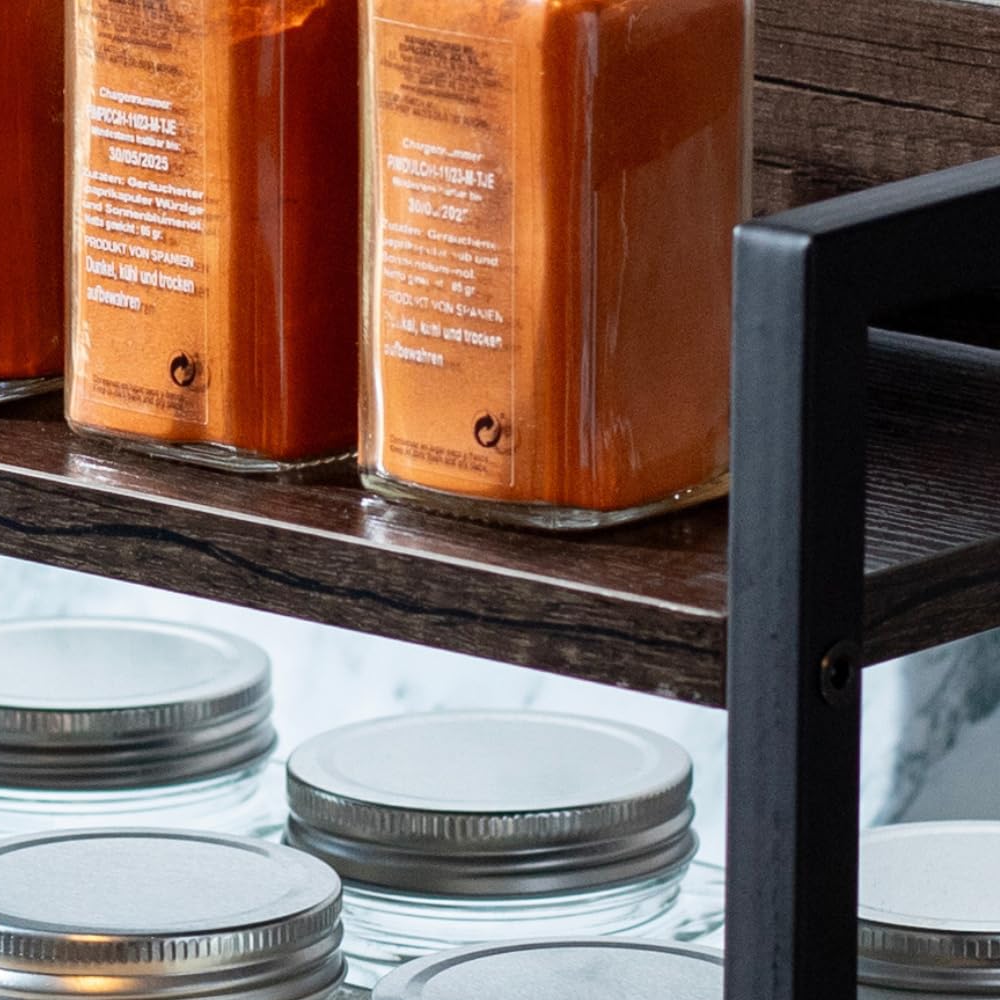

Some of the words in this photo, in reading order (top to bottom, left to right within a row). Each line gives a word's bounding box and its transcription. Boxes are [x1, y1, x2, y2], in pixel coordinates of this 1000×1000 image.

[108, 146, 170, 172] 30/05/2025
[127, 175, 204, 199] Geräucherter
[84, 235, 127, 255] PRODUKT
[129, 244, 150, 260] VON
[151, 249, 194, 268] SPANIEN
[474, 255, 498, 268] und
[139, 269, 158, 287] und
[159, 271, 195, 294] trocken
